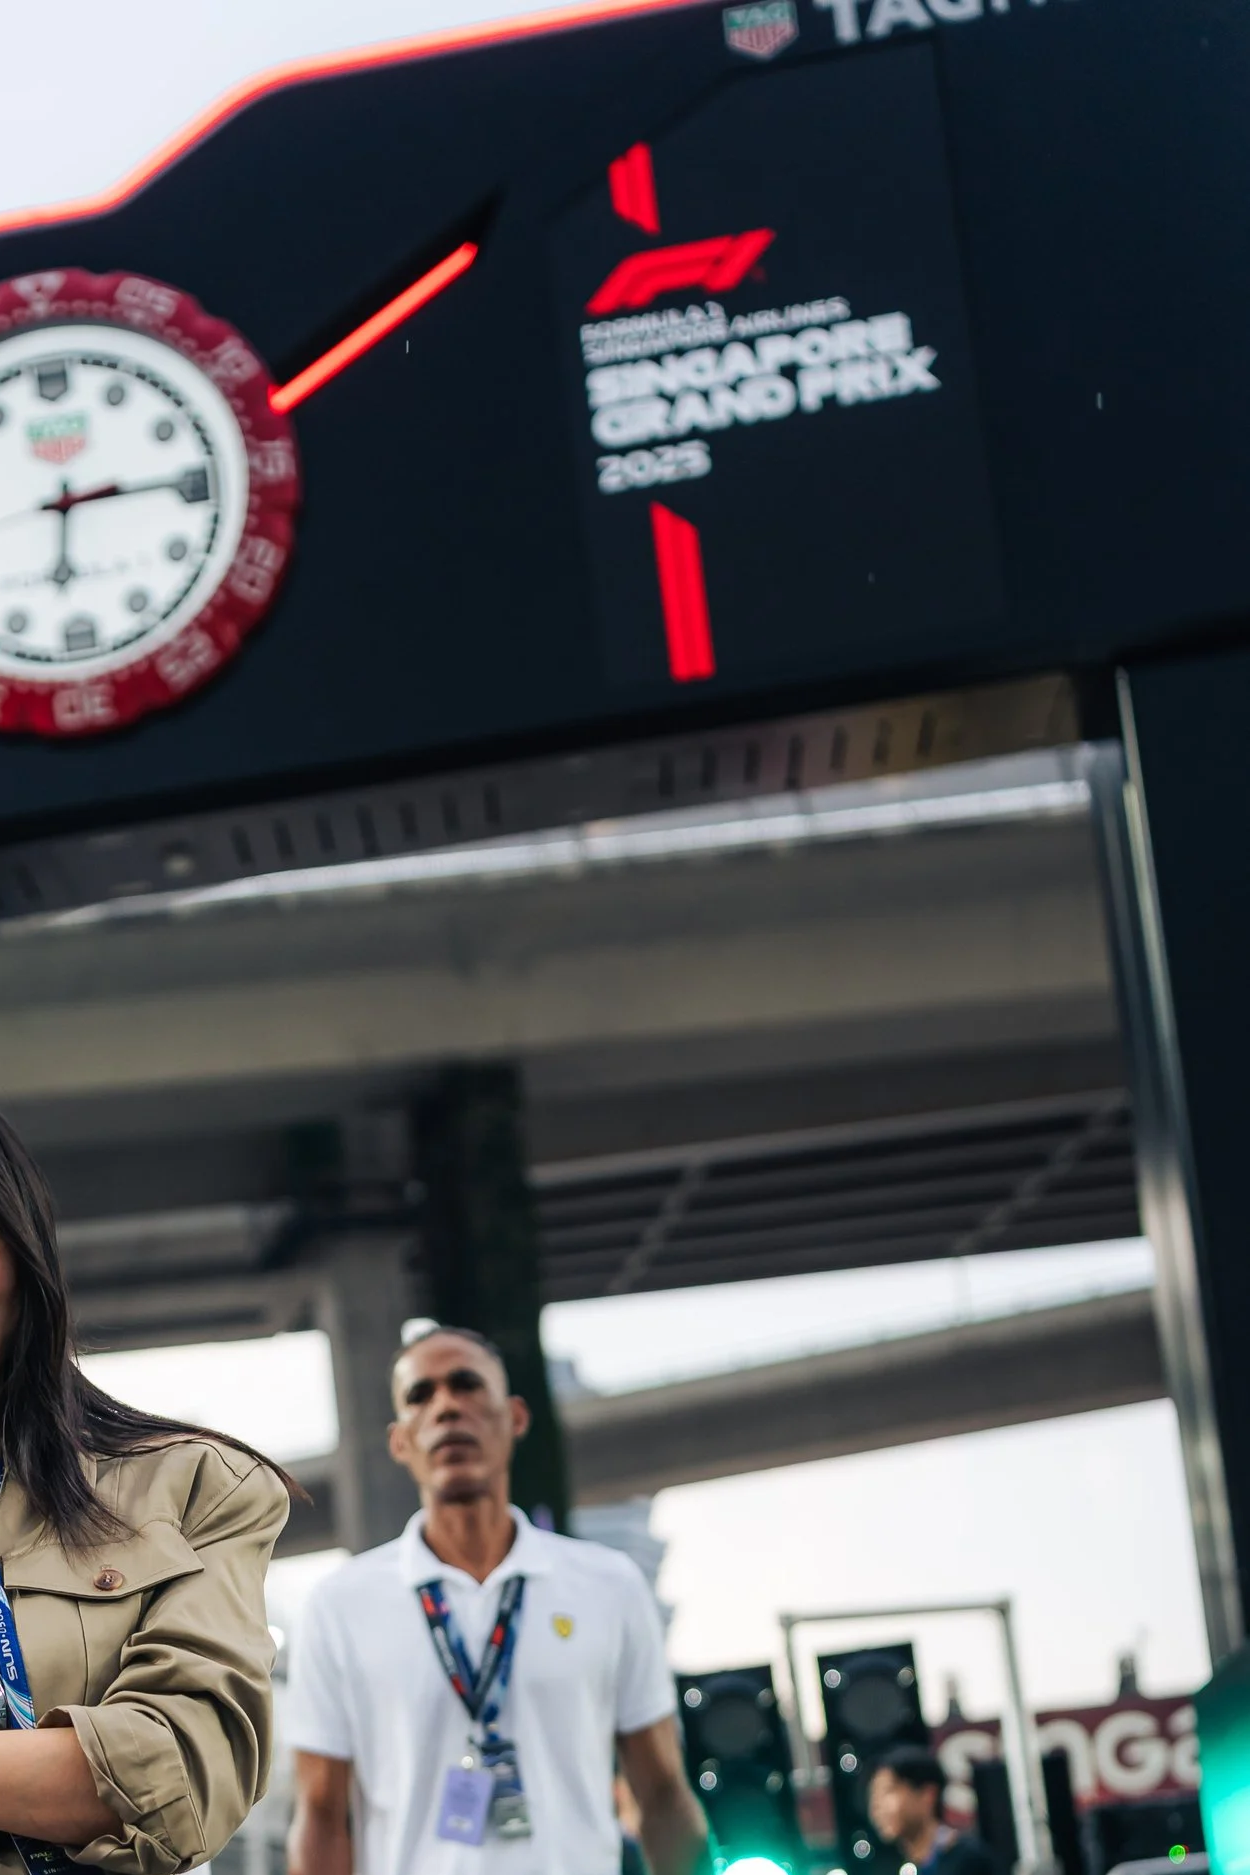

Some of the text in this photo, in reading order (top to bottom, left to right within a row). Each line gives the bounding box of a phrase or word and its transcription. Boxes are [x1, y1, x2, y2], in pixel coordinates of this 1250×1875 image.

[586, 311, 914, 410] SINGAPORE
[591, 344, 942, 448] GRAND PRIX
